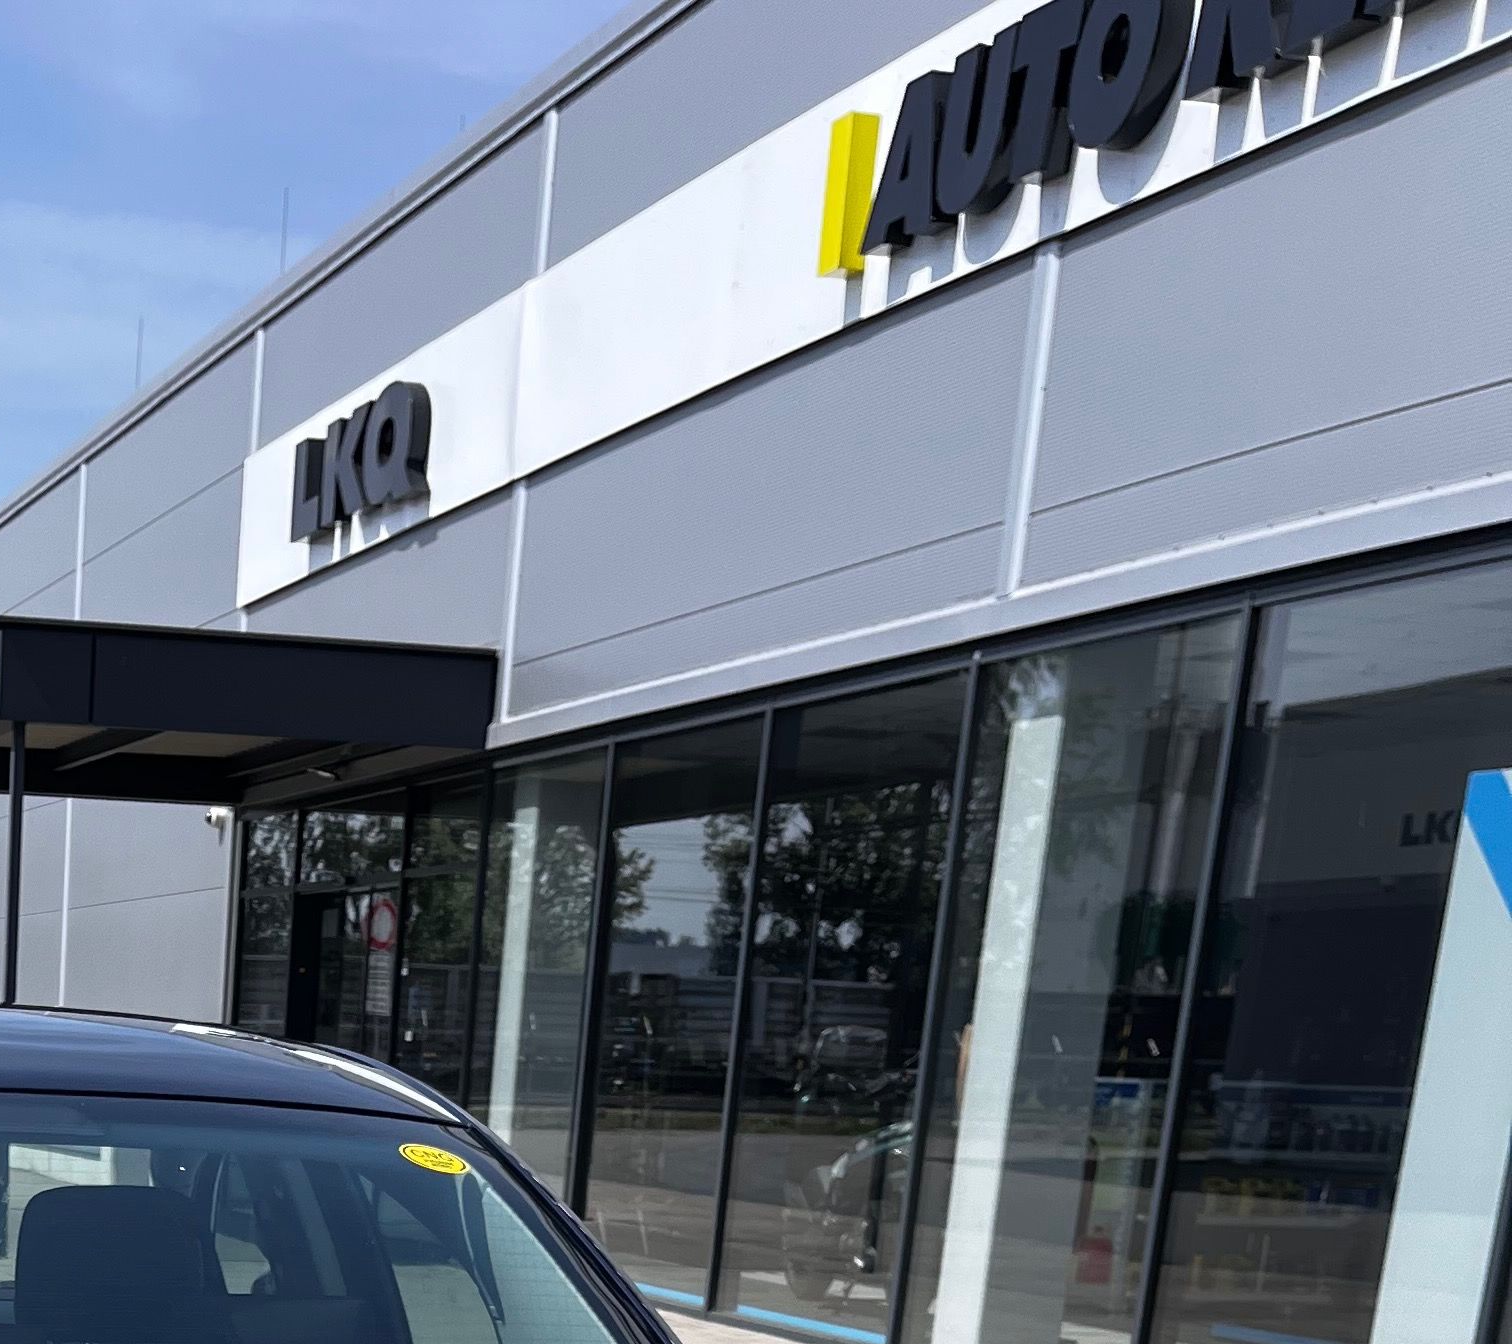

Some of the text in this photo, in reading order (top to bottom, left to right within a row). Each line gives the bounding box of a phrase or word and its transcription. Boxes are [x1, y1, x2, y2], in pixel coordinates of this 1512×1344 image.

[861, 0, 1188, 256] AUTO
[291, 381, 431, 542] LKQ
[1399, 809, 1457, 846] LK
